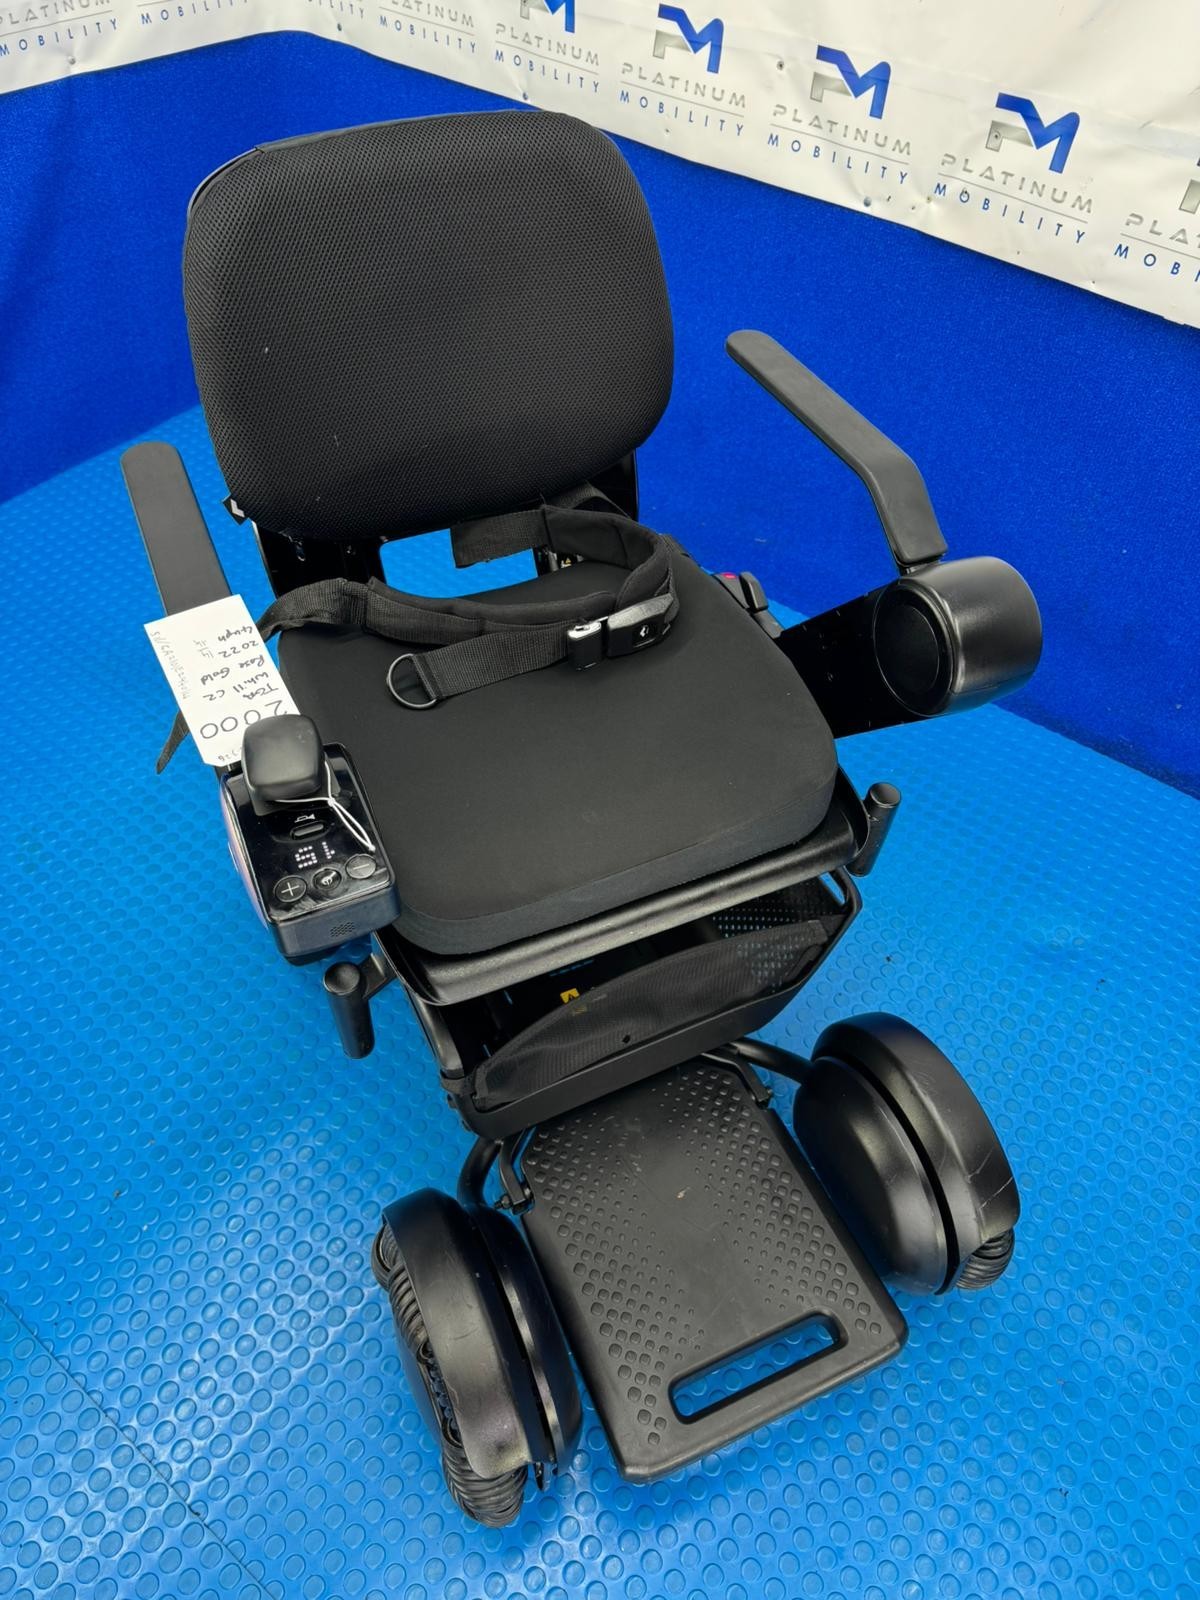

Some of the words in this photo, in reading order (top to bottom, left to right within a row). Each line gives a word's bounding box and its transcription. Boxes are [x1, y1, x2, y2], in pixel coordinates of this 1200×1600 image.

[140, 0, 248, 25] MOBILI
[379, 15, 476, 53] MOBILITY
[0, 18, 117, 56] MOBILITY
[495, 22, 600, 67] PLATINUM
[494, 49, 600, 93] MOBILITY
[621, 61, 747, 109] PLATINUM
[619, 89, 745, 137] MOBILITY
[772, 103, 912, 156] PLATINUM
[767, 133, 909, 185] MOBILITY
[940, 153, 1093, 214] PLATINUM
[934, 182, 1086, 244] MOBILITY
[1125, 212, 1200, 249] PLA
[218, 640, 260, 659] 2022
[200, 667, 231, 686] Gold
